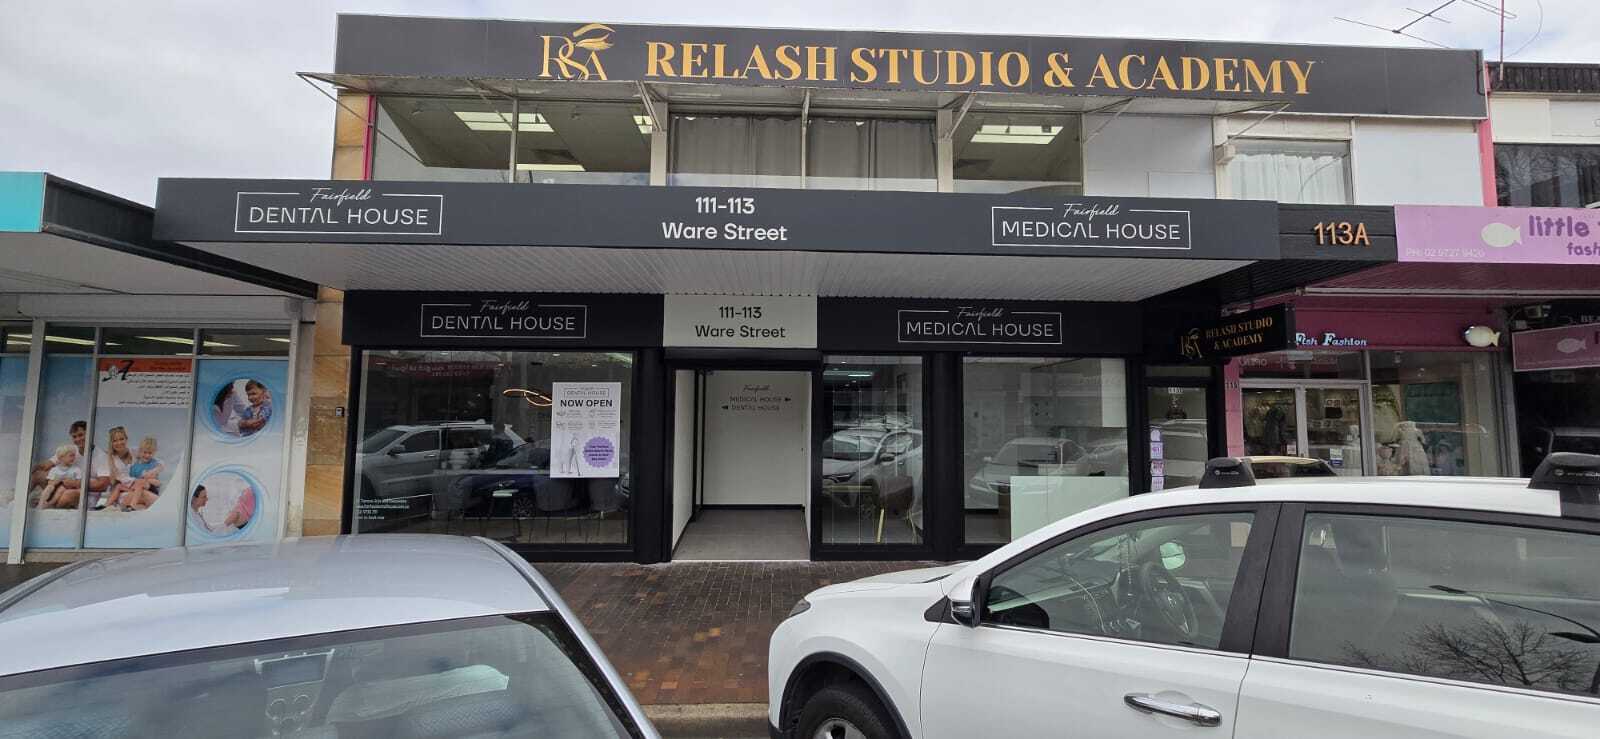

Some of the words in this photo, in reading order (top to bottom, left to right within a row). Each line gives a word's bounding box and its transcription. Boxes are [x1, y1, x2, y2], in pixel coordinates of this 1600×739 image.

[645, 41, 837, 82] RELASH
[850, 47, 1030, 87] STUDIO
[1043, 51, 1075, 88] &
[1086, 53, 1315, 95] ACADEMY
[310, 187, 372, 208] Fairfield
[695, 196, 756, 215] 111-113
[249, 206, 339, 225] DENTAL
[347, 207, 429, 226] HOUSE
[1063, 203, 1120, 221] Fairfield
[662, 222, 718, 240] Ware
[723, 222, 789, 241] Street
[1002, 220, 1100, 239] MEDICAL
[1106, 223, 1182, 240] HOUSE
[1313, 221, 1371, 247] 113A
[1528, 214, 1590, 237] little
[479, 299, 530, 315] Fairfield
[718, 306, 763, 319] 111-113
[956, 305, 1004, 321] Fairfield
[432, 315, 504, 330] DENTAL
[510, 316, 576, 331] HOUSE
[694, 325, 735, 338] Ware
[740, 324, 786, 338] Street
[906, 321, 987, 336] MEDICAL
[992, 323, 1054, 337] HOUSE
[1237, 316, 1273, 333] STUDIO
[1222, 332, 1265, 350] ACADEMY
[1322, 332, 1367, 346] Fashion
[560, 399, 583, 407] NOW
[586, 399, 613, 408] OPEN
